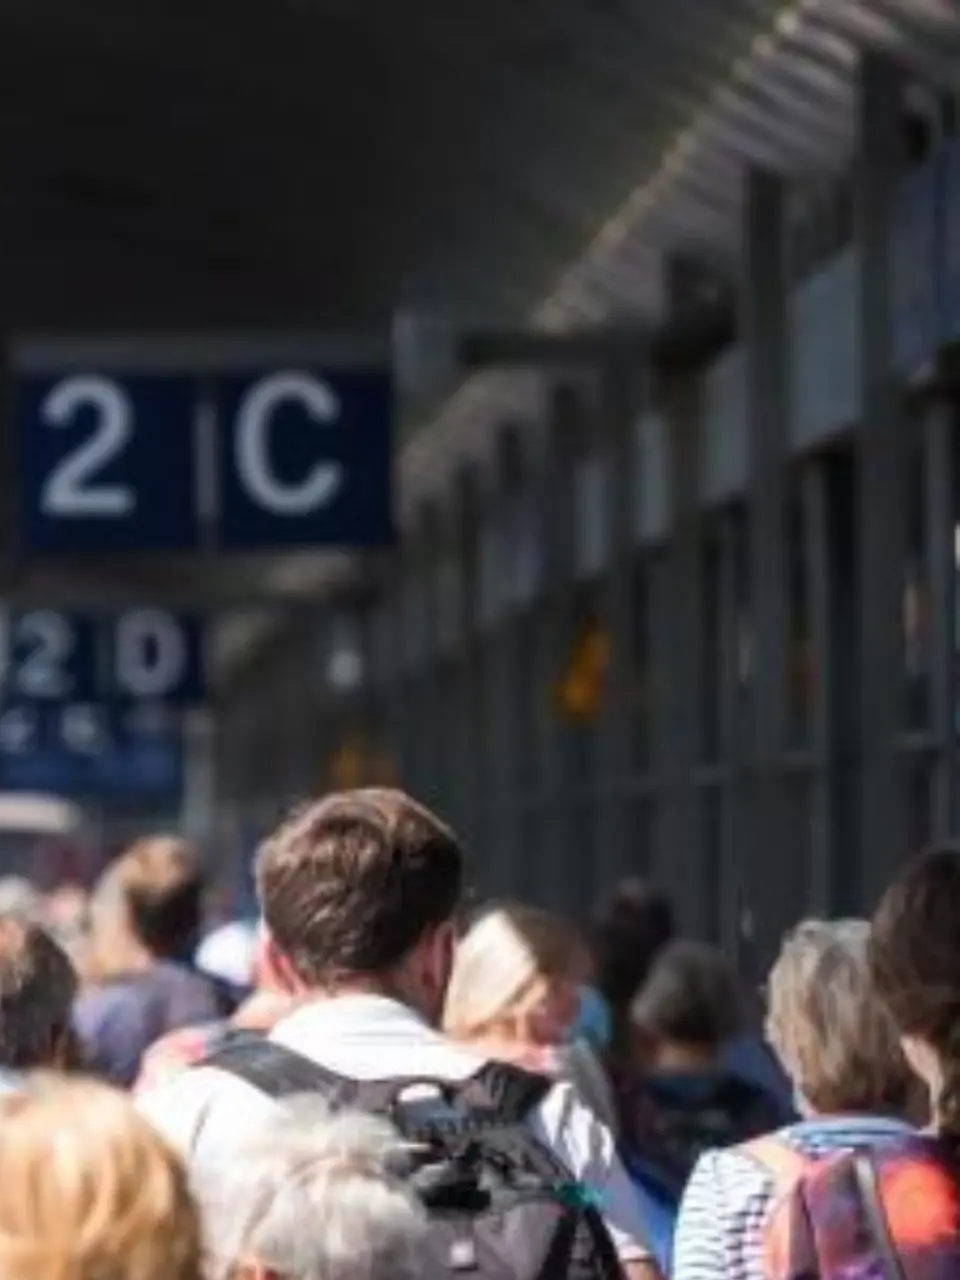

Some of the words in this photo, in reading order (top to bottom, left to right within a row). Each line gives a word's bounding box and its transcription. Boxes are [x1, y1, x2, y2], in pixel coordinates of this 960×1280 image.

[42, 374, 134, 514] 2
[235, 371, 341, 514] C
[16, 609, 74, 696] 2
